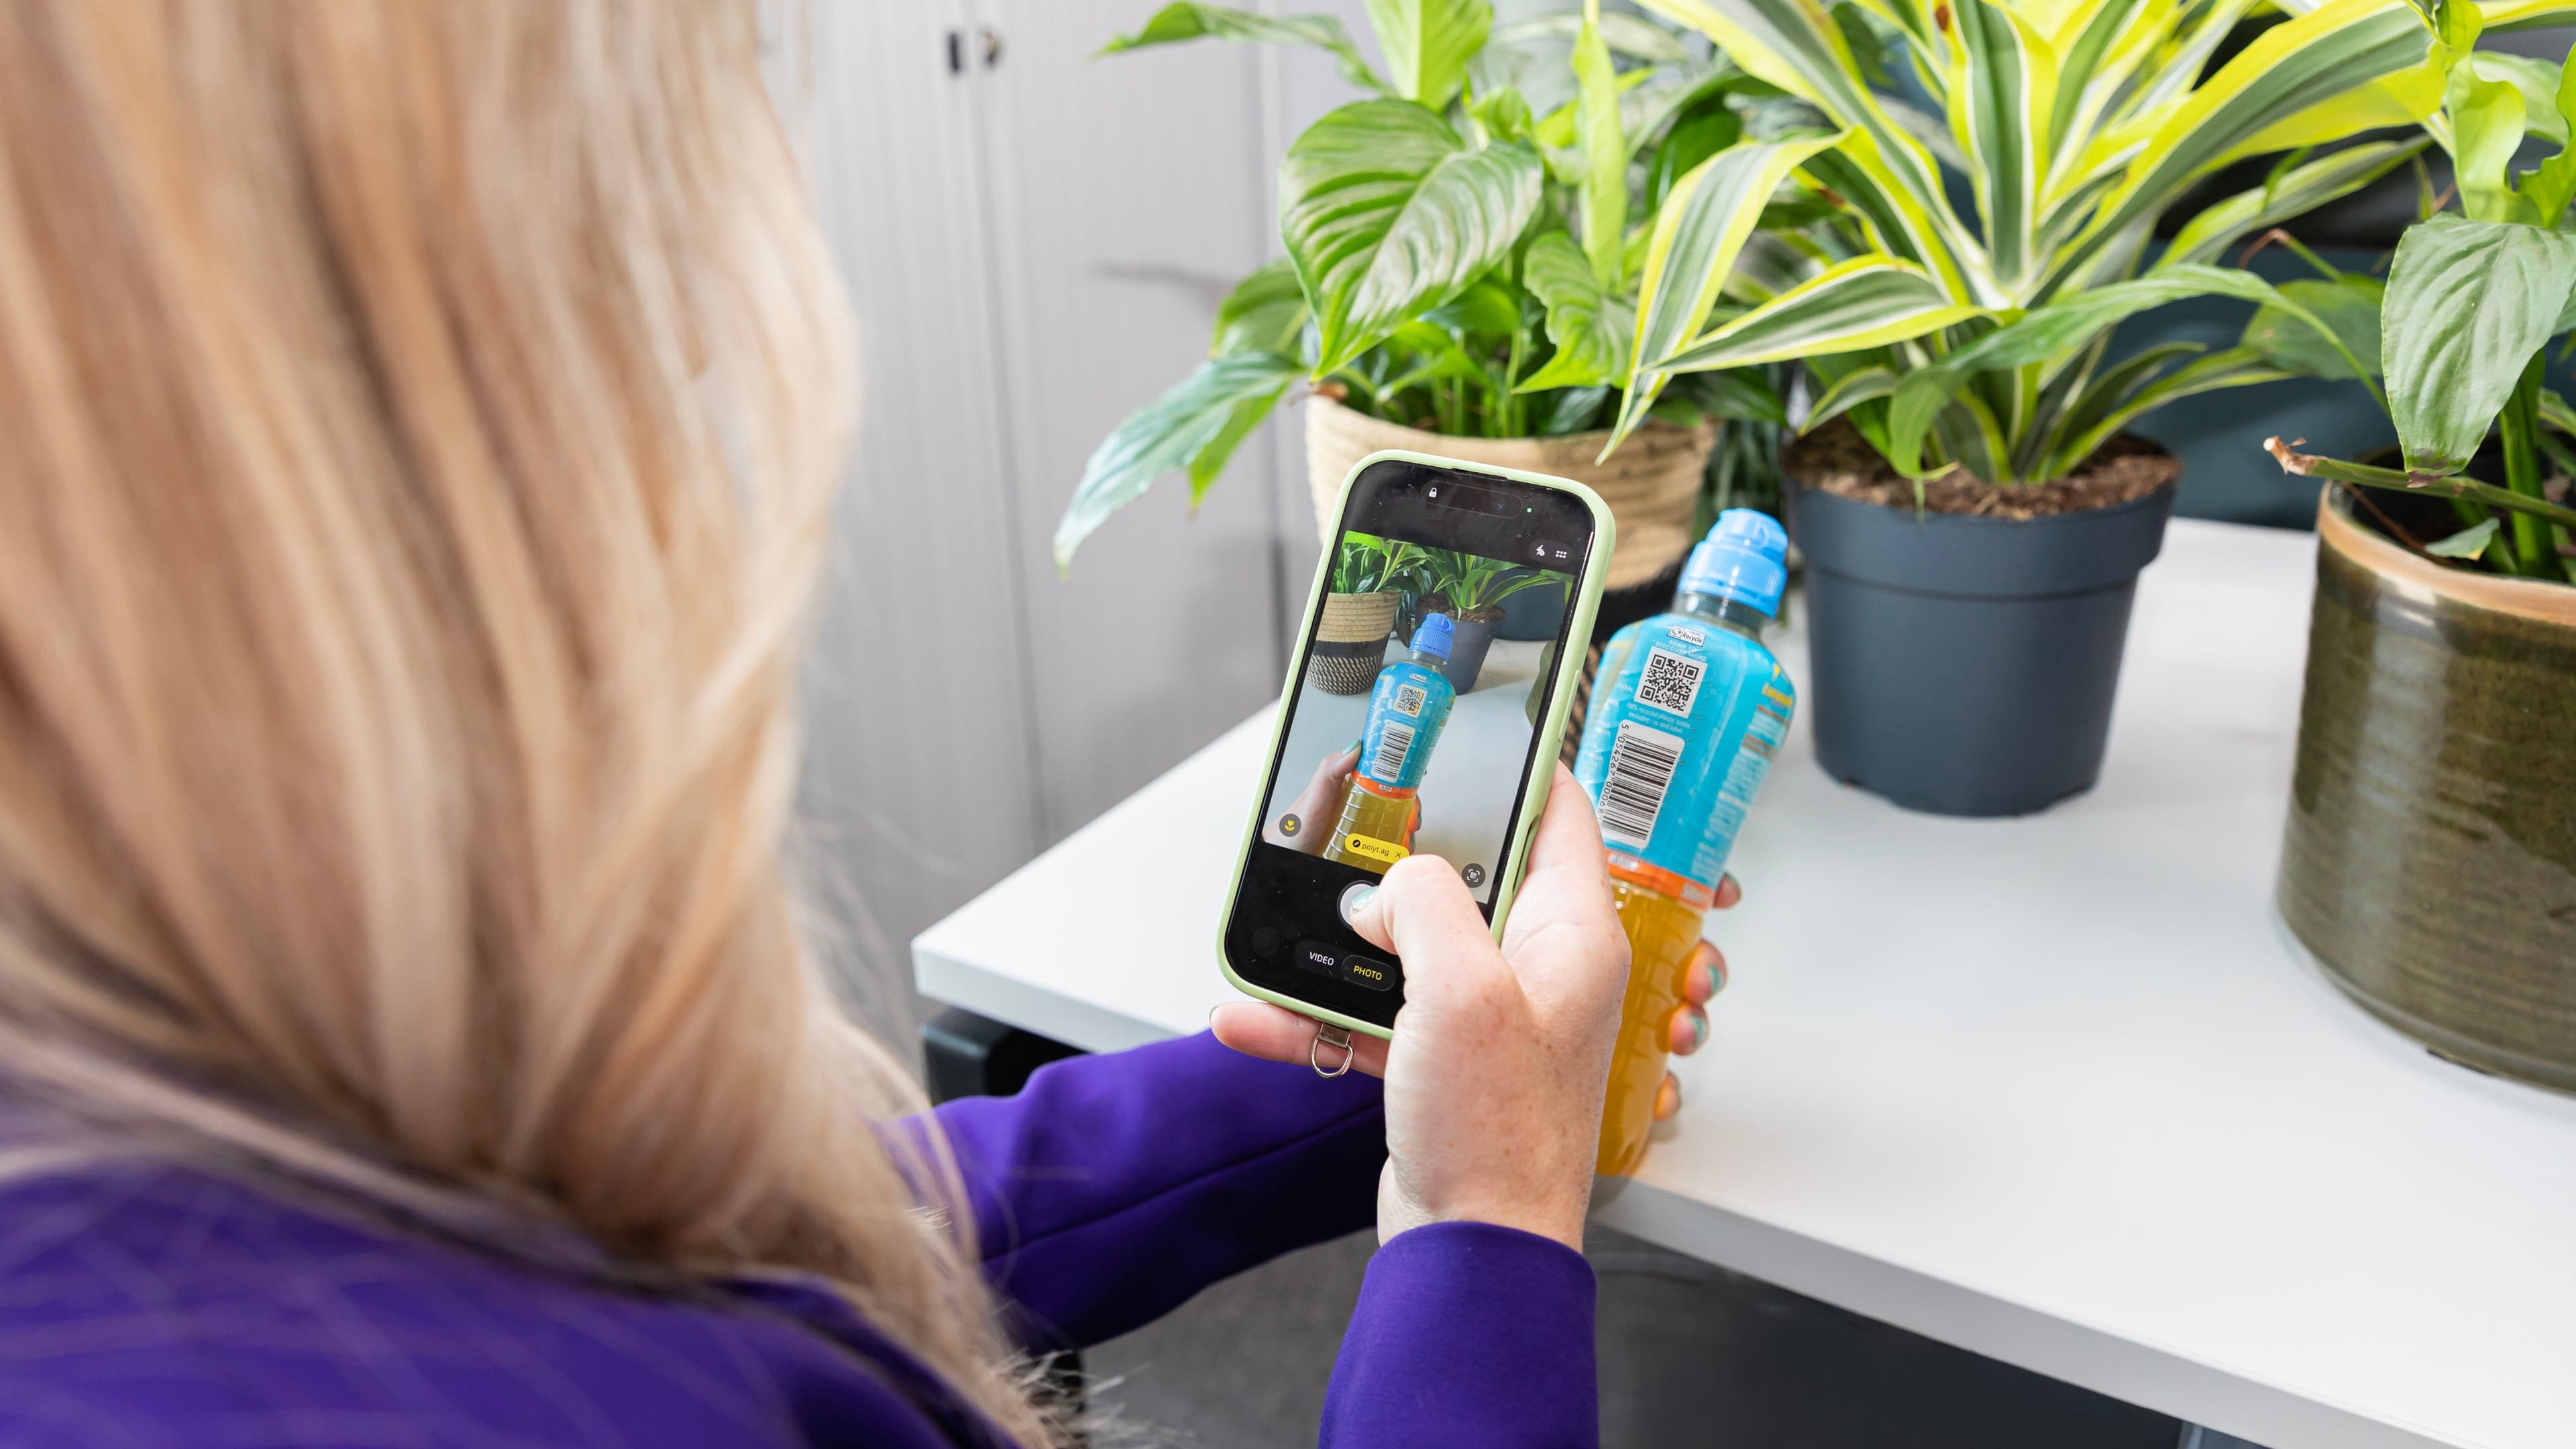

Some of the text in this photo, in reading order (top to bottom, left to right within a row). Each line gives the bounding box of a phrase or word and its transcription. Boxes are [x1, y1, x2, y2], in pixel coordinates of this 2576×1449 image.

[1682, 633, 1703, 643] Recycle
[1655, 641, 1687, 655] DISCOVER
[1610, 736, 1625, 777] 054267
[1362, 843, 1390, 857] polyt.ag
[1309, 951, 1334, 966] VIDEO
[1353, 965, 1383, 981] PHOTO
